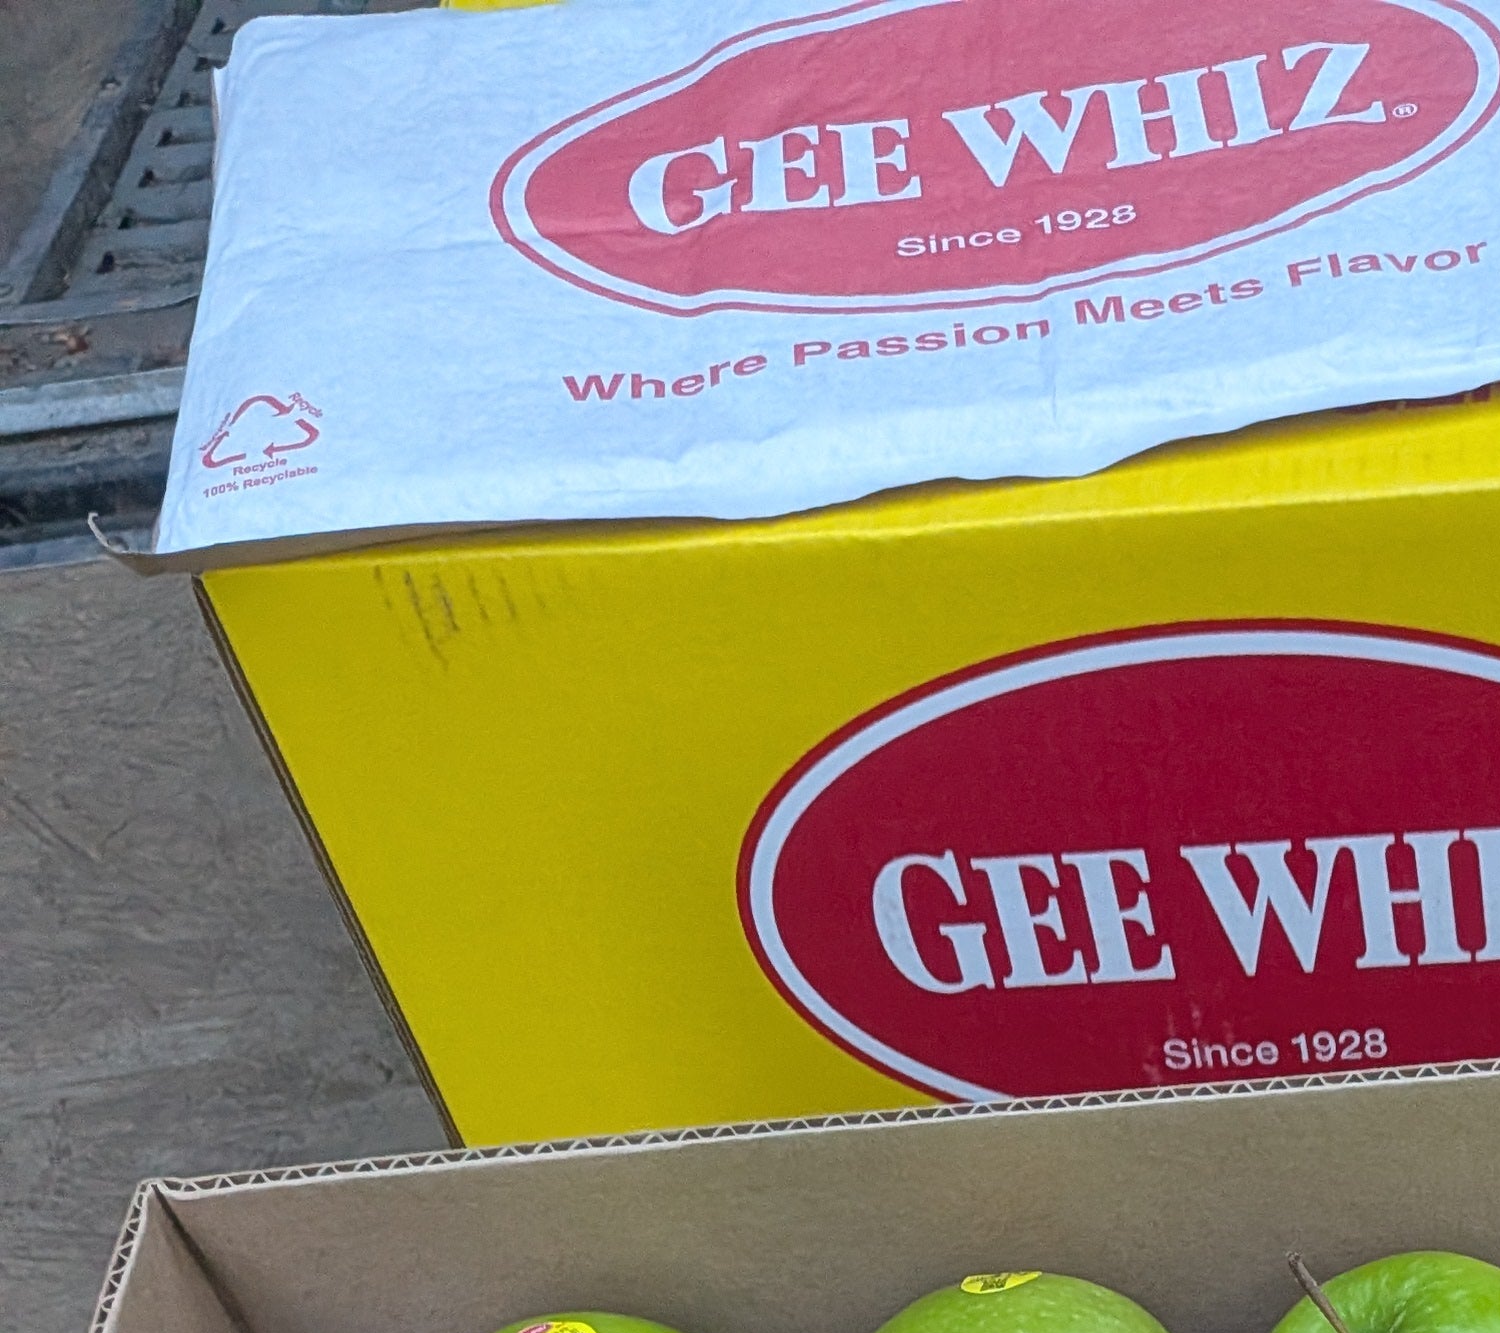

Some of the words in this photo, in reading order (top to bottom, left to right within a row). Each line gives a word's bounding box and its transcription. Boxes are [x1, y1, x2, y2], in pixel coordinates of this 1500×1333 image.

[628, 118, 922, 235] GEE
[942, 41, 1386, 187] WHIZ
[897, 224, 1022, 257] Since
[1035, 204, 1137, 235] 1928
[562, 354, 767, 401] Where
[793, 319, 1050, 366] Passion
[1074, 278, 1264, 325] Meets
[1286, 242, 1487, 287] Flavor
[202, 481, 239, 498] 100%
[243, 465, 318, 490] Recyclable
[233, 457, 287, 476] Recycle
[872, 847, 1176, 995] GEE
[1163, 1038, 1279, 1070] Since
[1291, 1028, 1388, 1063] 1928
